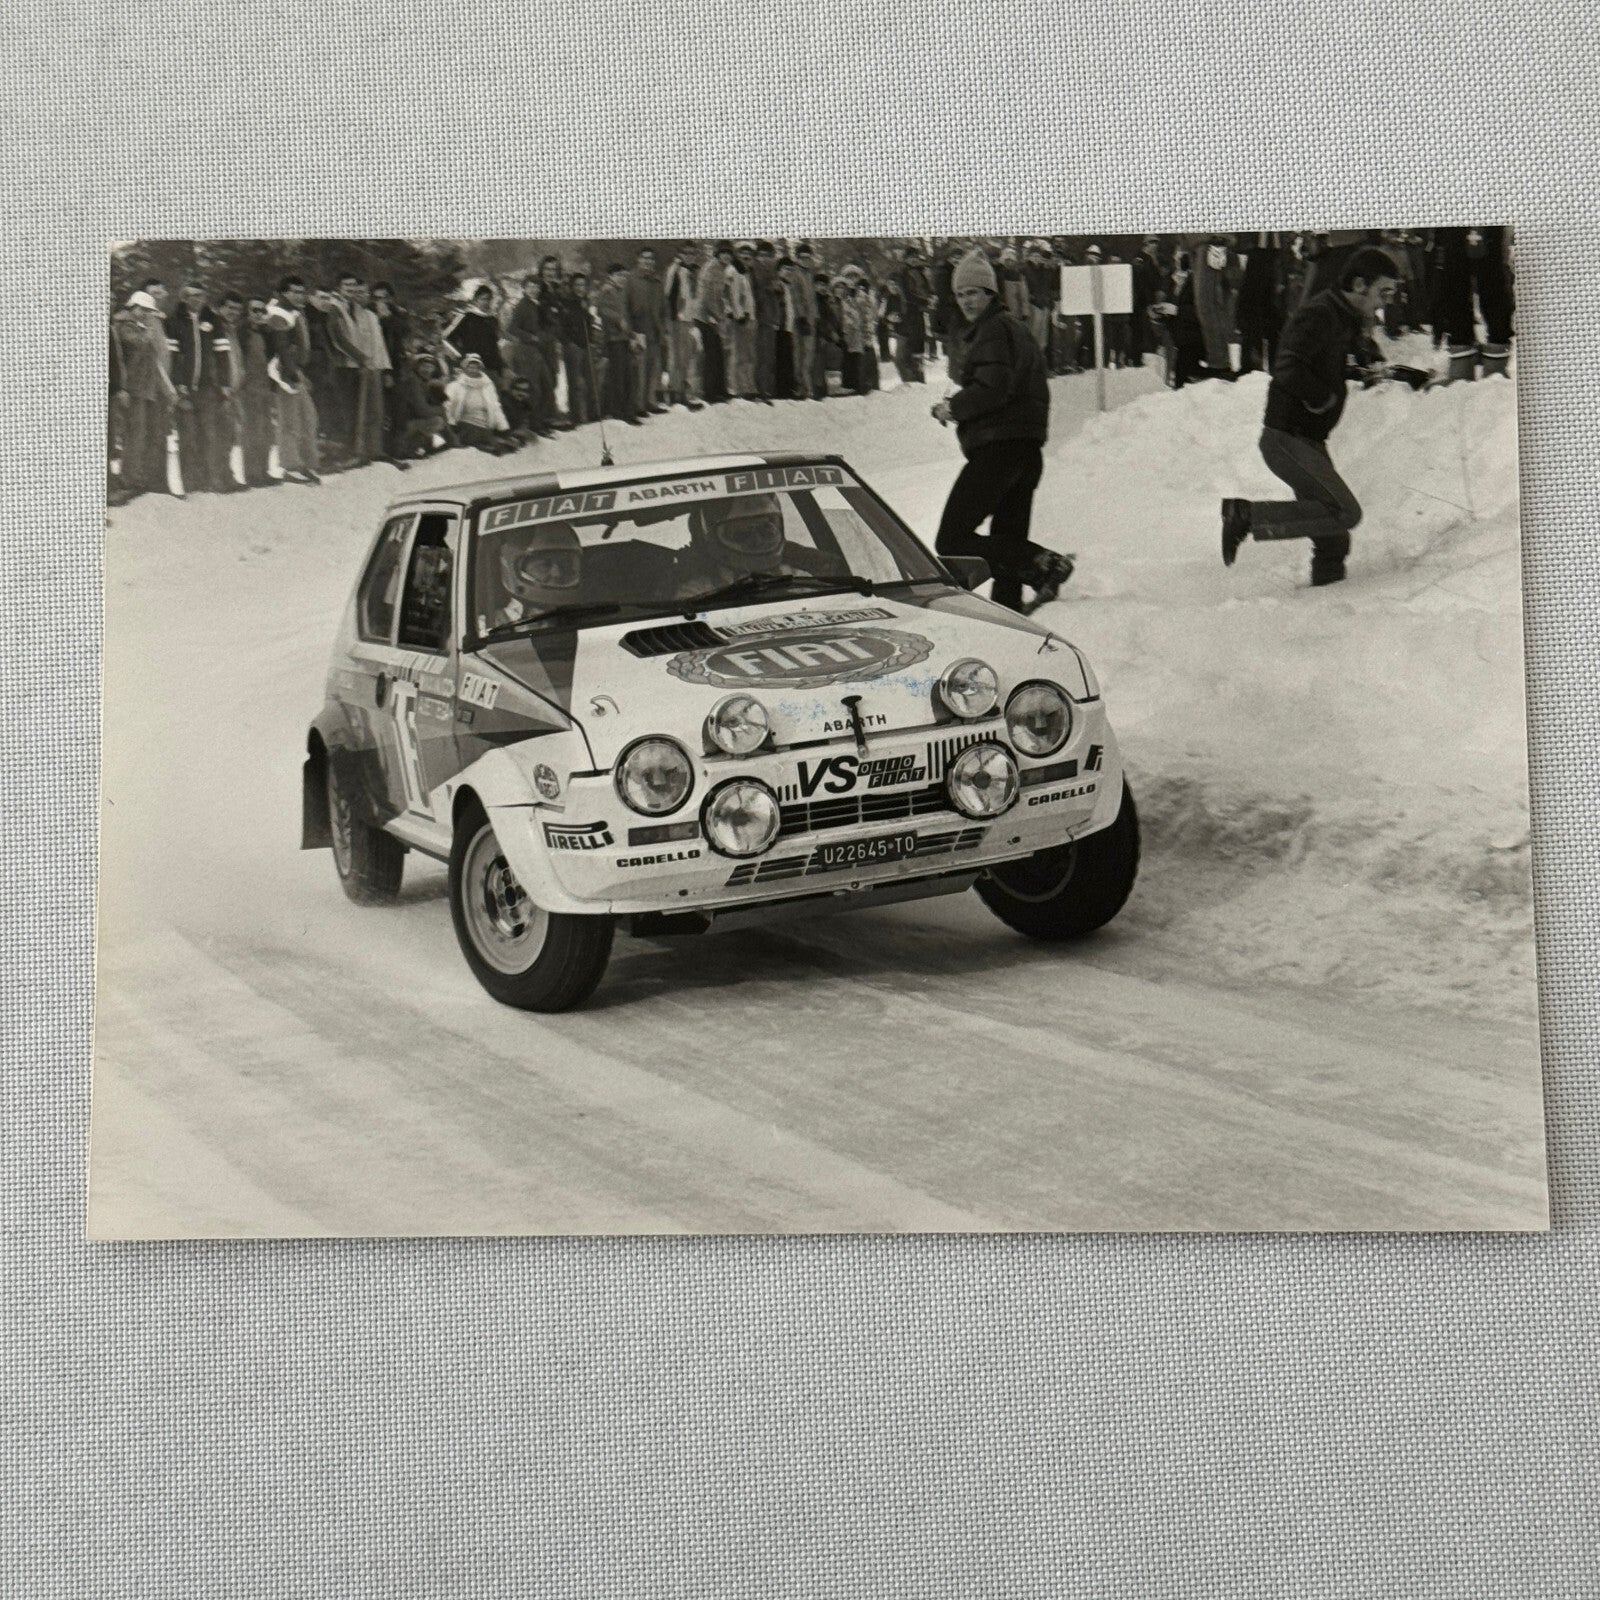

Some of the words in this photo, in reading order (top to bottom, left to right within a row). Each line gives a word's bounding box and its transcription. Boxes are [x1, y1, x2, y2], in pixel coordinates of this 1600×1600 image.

[496, 491, 610, 526] FIAT
[627, 480, 716, 503] ABARTH
[732, 468, 840, 491] FIAT
[724, 637, 873, 675] FIAT
[463, 675, 499, 706] FIAT
[797, 755, 860, 798] VS
[857, 757, 915, 776] OLIO
[868, 768, 926, 789] FIAT
[1027, 784, 1096, 807] CARELLO
[541, 820, 615, 851] PIRELLI
[823, 843, 888, 865] U22645
[893, 836, 916, 853] TO
[616, 849, 701, 868] CARELLO
